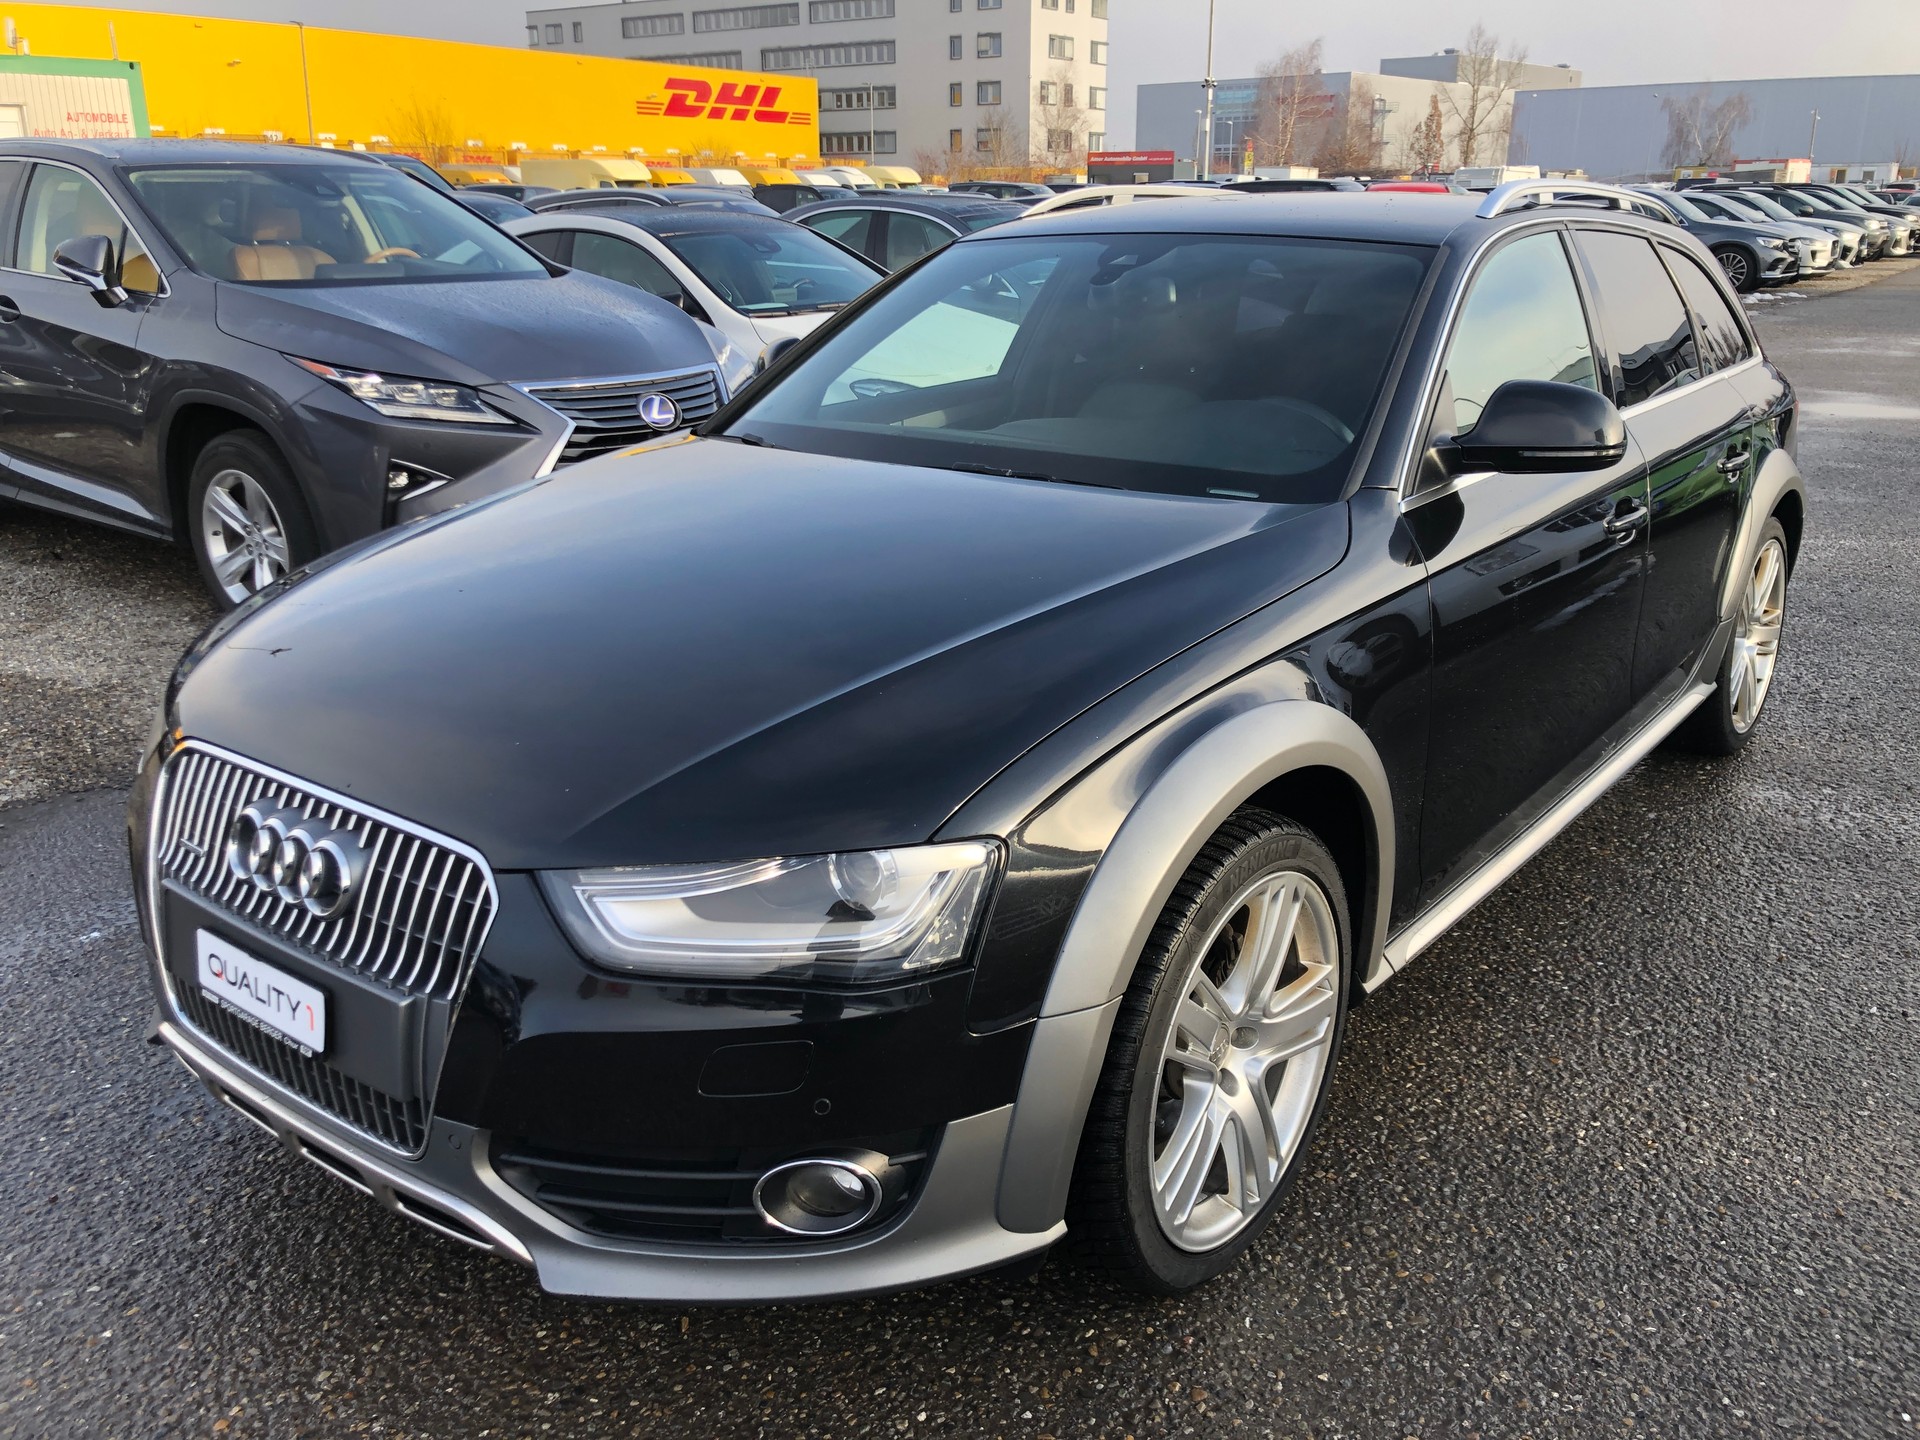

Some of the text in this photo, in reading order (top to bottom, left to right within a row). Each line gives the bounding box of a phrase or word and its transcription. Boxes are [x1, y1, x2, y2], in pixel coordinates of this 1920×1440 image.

[66, 112, 128, 123] AUTOMOBILE
[663, 77, 789, 124] DHL
[1229, 839, 1298, 893] NANKANG
[208, 953, 301, 1021] QUALITY
[305, 1004, 315, 1032] 1
